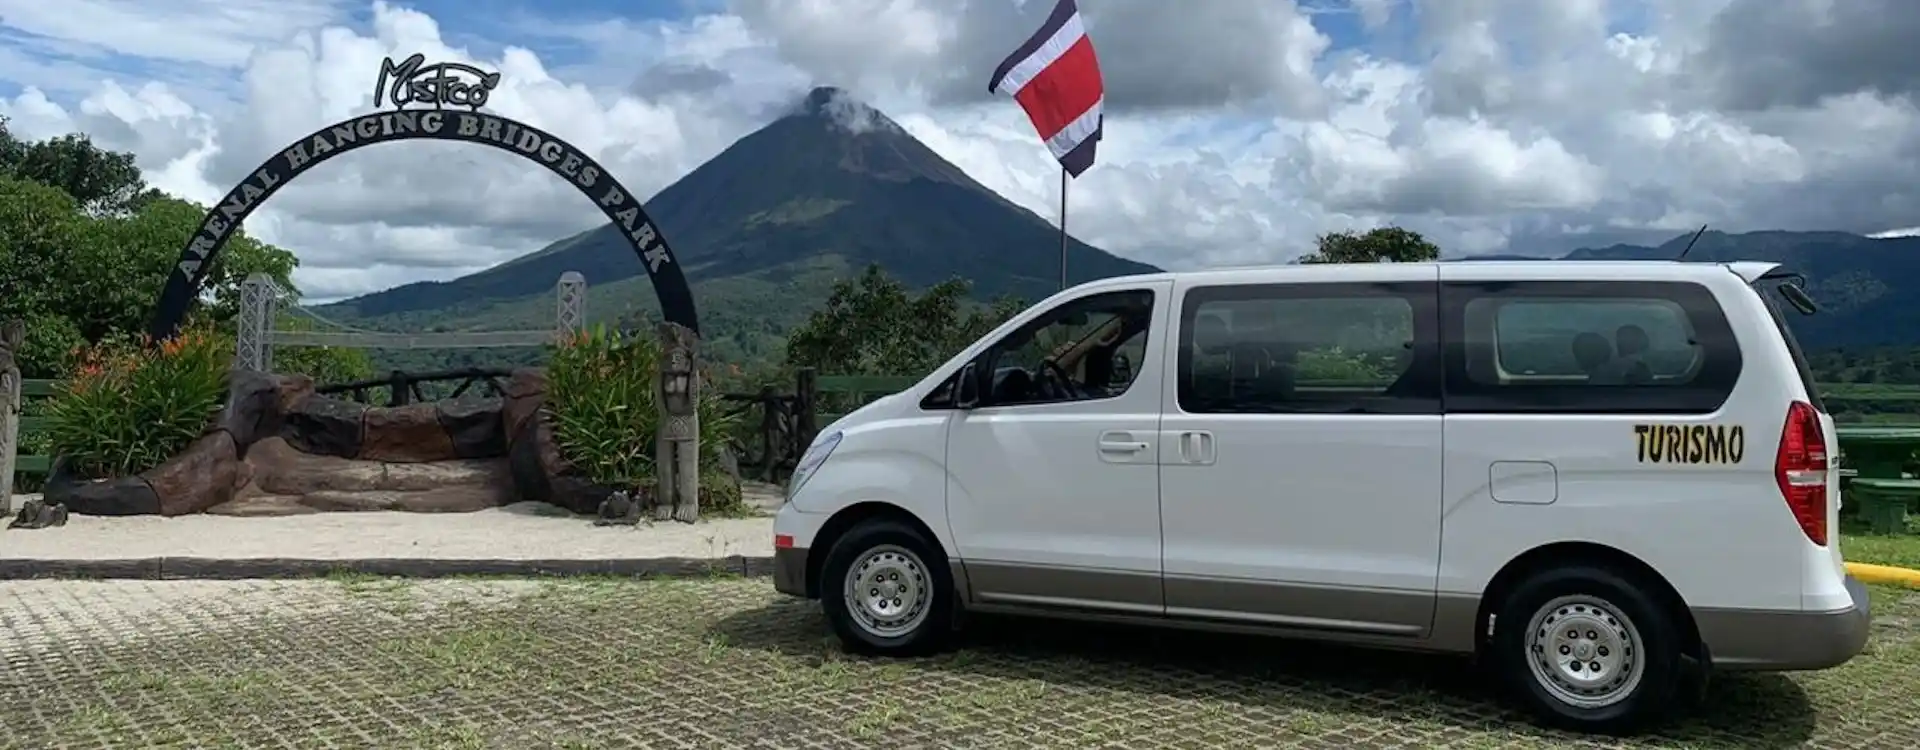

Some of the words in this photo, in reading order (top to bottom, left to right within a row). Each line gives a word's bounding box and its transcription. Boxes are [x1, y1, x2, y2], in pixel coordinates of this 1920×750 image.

[178, 168, 279, 281] ARENAL
[284, 111, 444, 171] HANGING
[457, 113, 600, 188] BRIDGES
[601, 186, 670, 273] PARK
[1634, 424, 1744, 464] TURISMO
